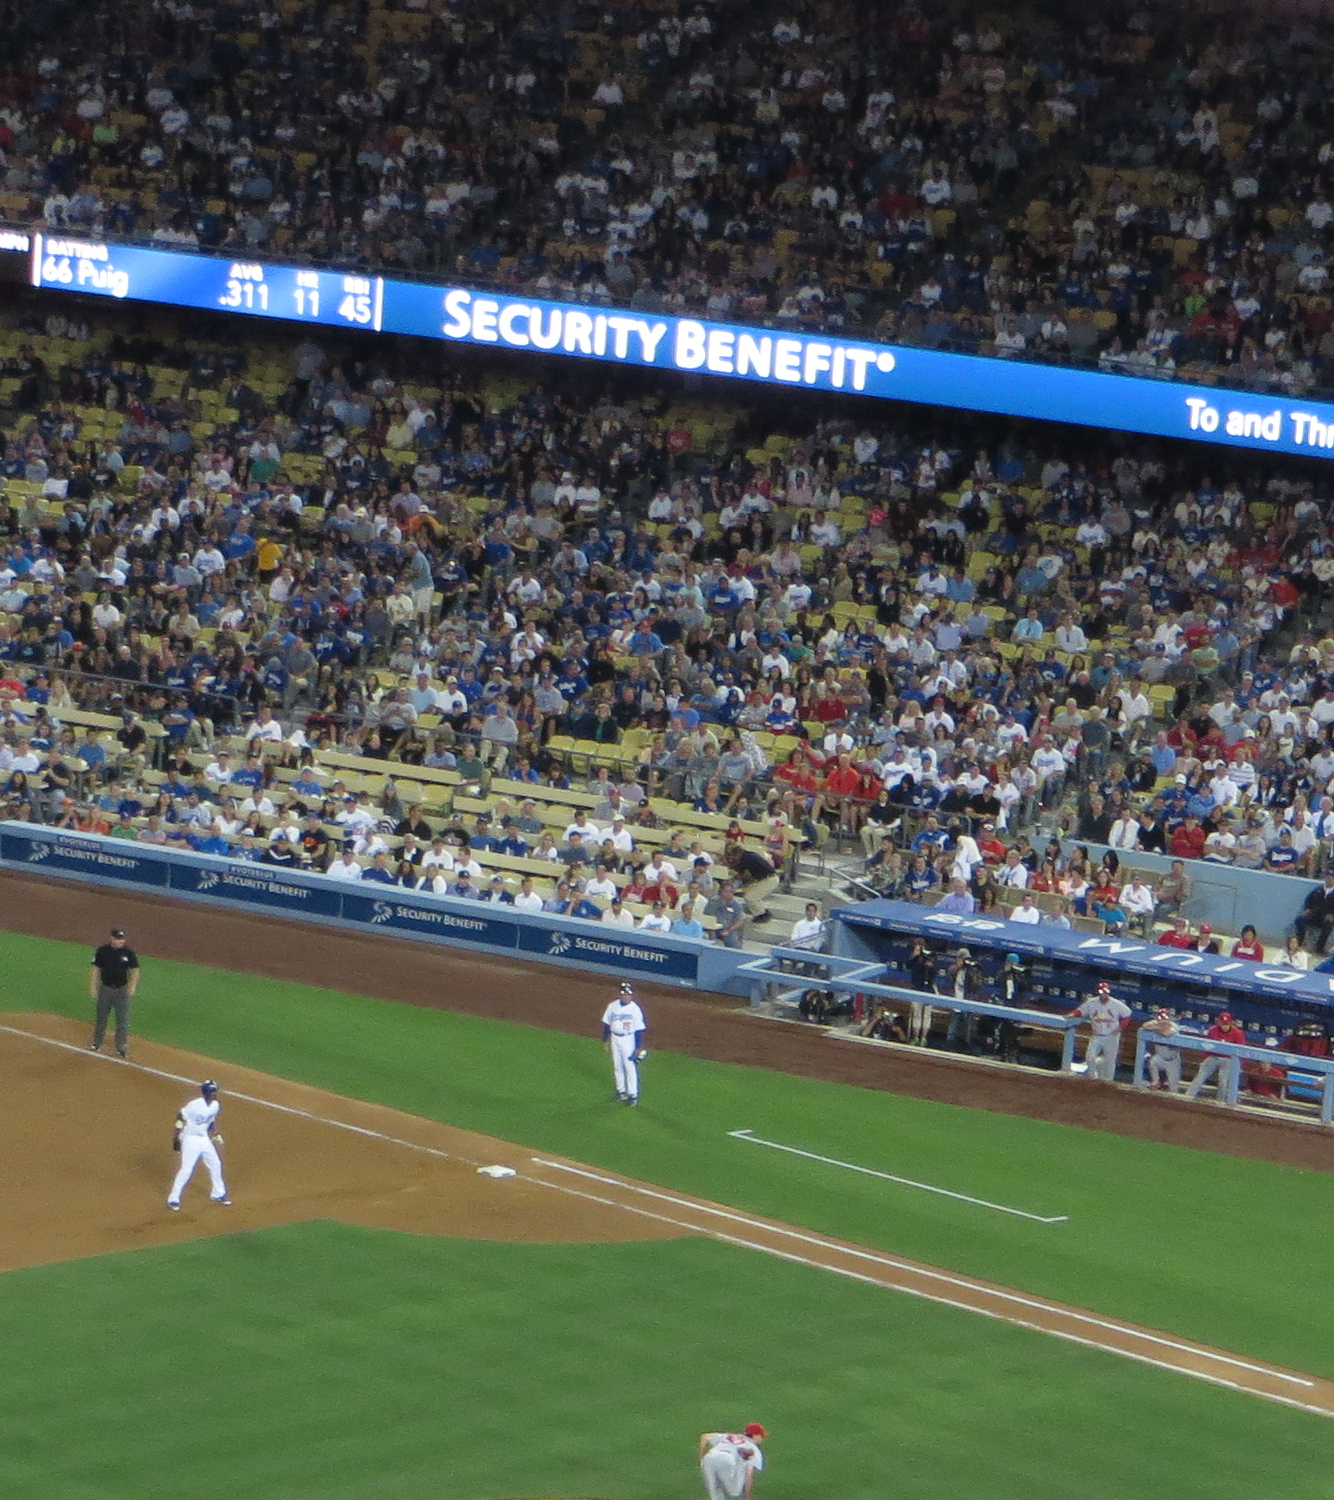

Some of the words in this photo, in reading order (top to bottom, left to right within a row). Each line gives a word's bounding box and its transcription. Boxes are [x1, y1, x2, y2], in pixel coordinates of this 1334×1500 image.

[48, 239, 108, 262] BATTING
[42, 256, 73, 284] 66
[78, 258, 129, 299] Puig
[230, 264, 263, 283] AVG
[297, 272, 319, 290] HR
[344, 277, 370, 296] RBI
[218, 281, 269, 311] .311
[294, 289, 320, 317] 11
[338, 295, 371, 325] 45
[444, 290, 666, 362] SECURITY
[1186, 398, 1219, 432] To
[1226, 410, 1281, 441] and
[53, 845, 98, 863] SECURITY
[99, 851, 136, 869] BENEFIT
[223, 873, 268, 892] SECURITY
[269, 880, 309, 899] BENEFIT
[396, 905, 442, 924] SECURITY
[443, 914, 485, 932] BENEFIT
[575, 936, 622, 956] SECURITY
[623, 944, 665, 964] BENEFIT
